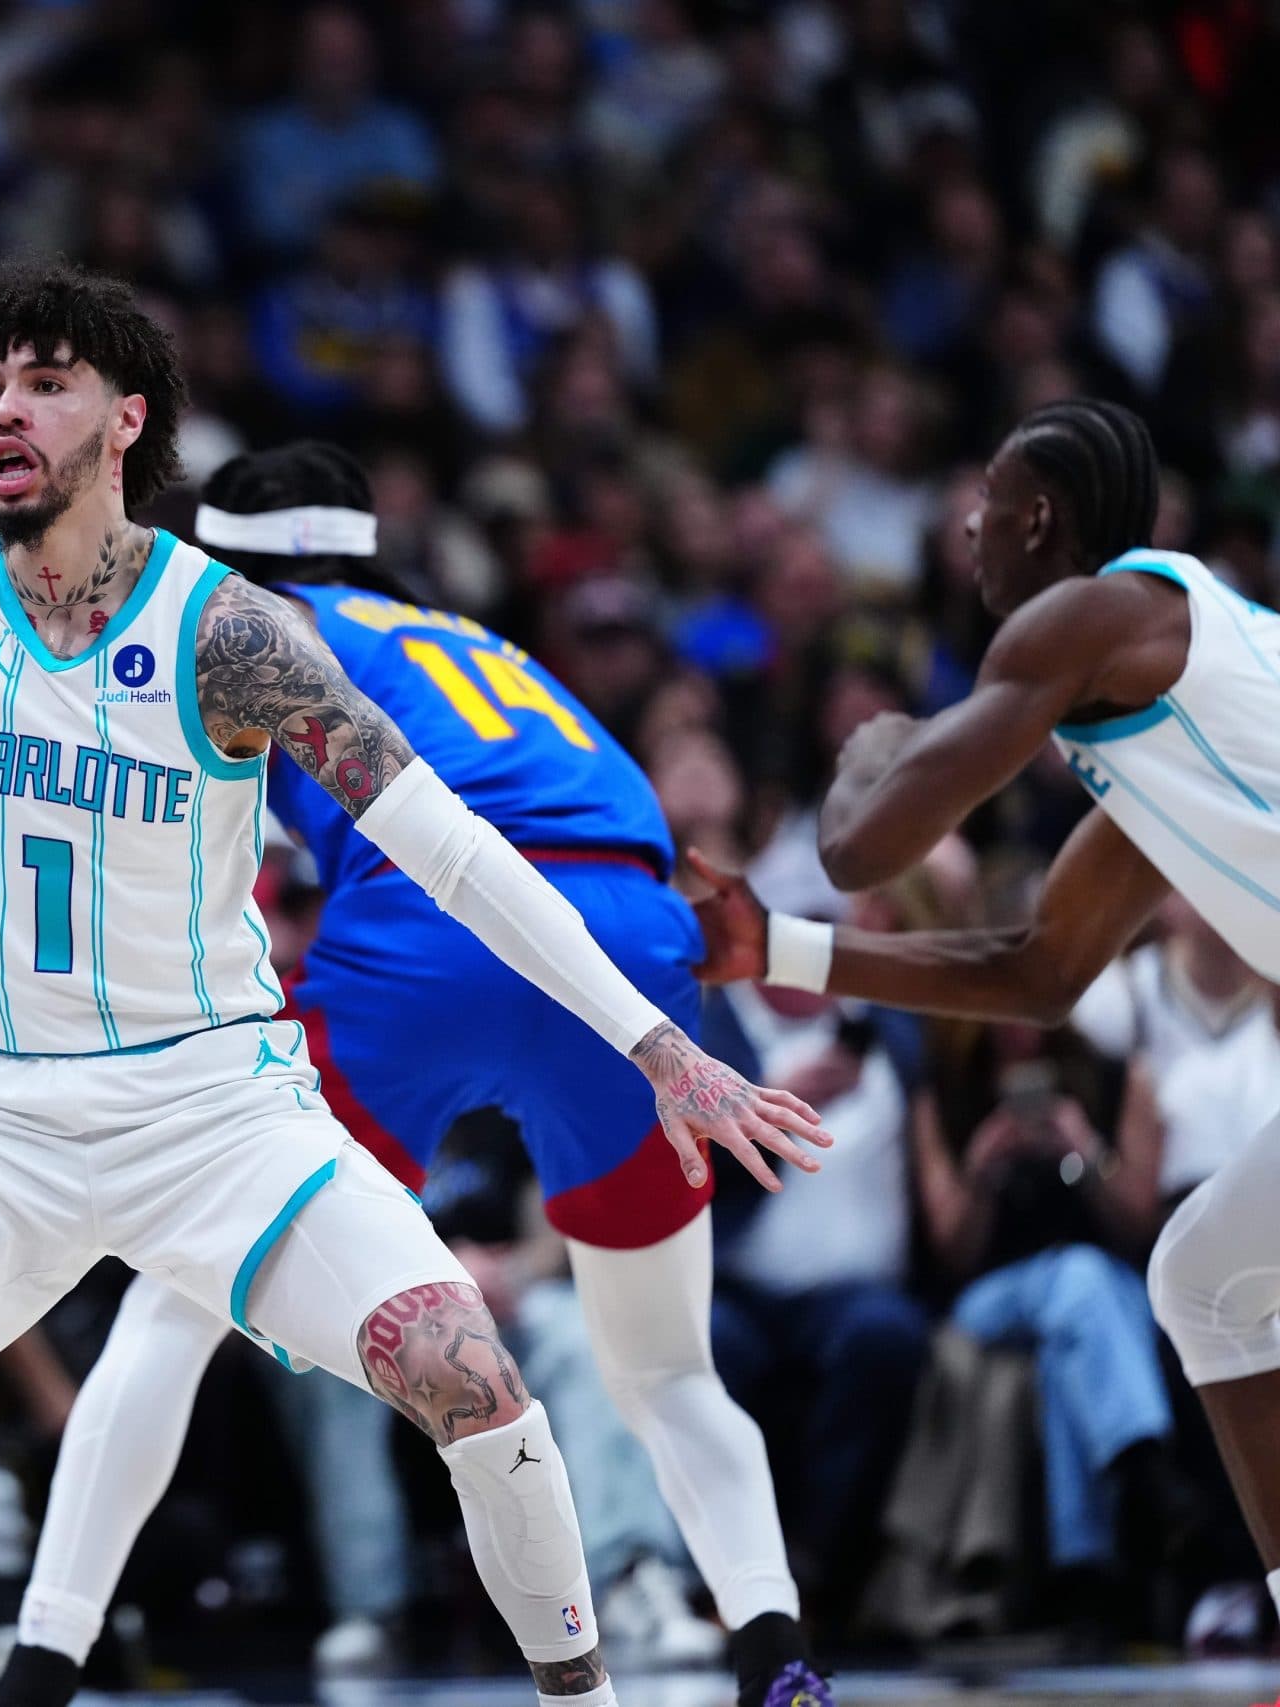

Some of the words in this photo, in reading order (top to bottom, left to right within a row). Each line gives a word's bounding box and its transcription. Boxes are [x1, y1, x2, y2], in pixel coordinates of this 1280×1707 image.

[97, 689, 128, 702] Judi
[130, 688, 171, 703] Health
[401, 636, 596, 752] 14
[22, 834, 73, 974] 1
